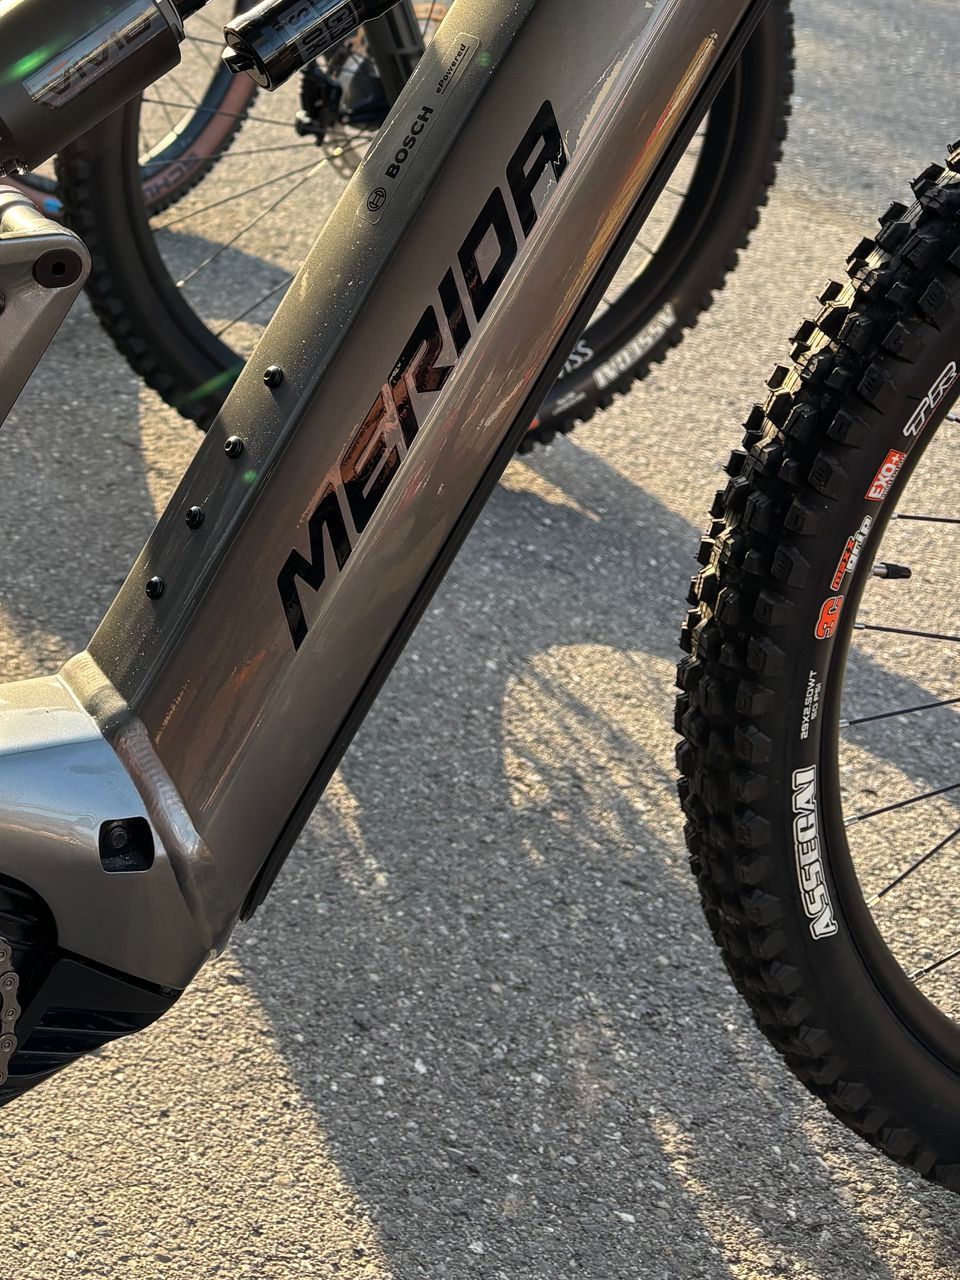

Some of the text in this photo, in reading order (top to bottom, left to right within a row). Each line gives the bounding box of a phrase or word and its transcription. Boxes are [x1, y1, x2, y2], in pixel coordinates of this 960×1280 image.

[385, 43, 466, 179] BOSCH ePowered
[276, 99, 569, 653] MERIDA
[868, 454, 901, 499] EXO+
[800, 670, 817, 740] 29X2.50WT
[813, 682, 822, 702] PSI
[791, 764, 839, 940] ASSEGAI
